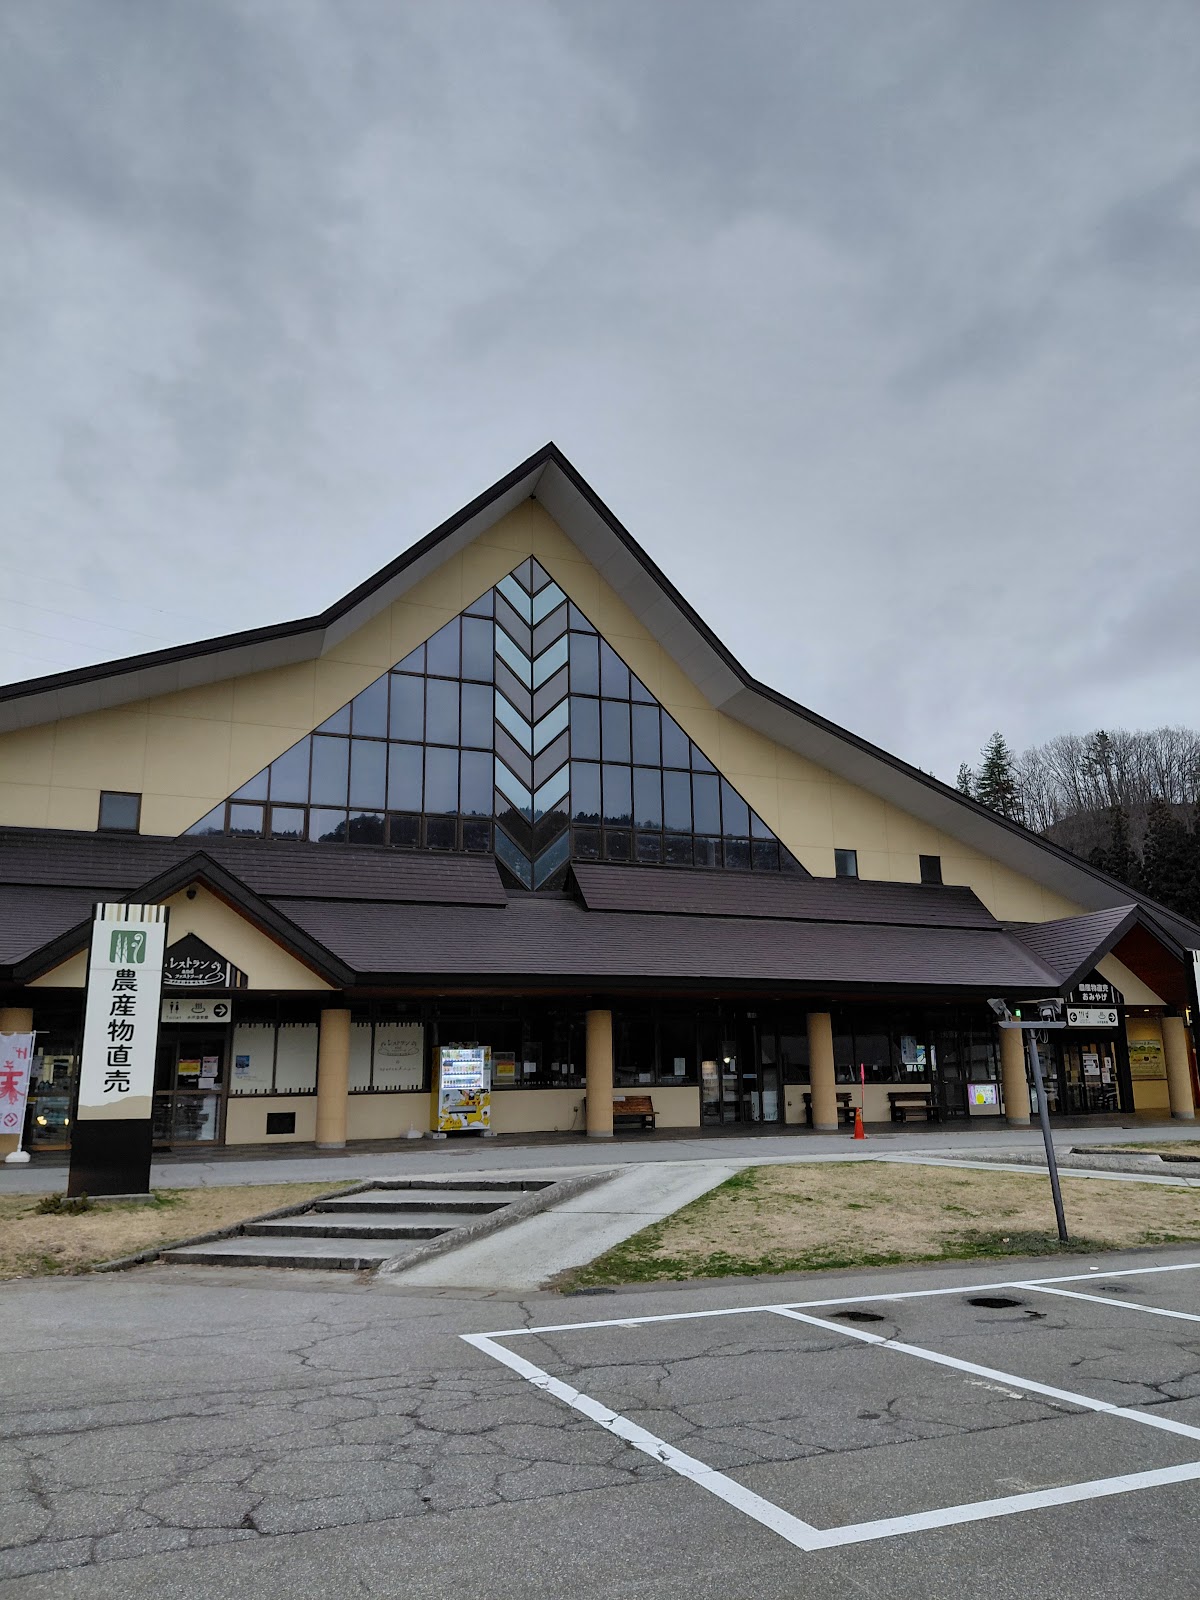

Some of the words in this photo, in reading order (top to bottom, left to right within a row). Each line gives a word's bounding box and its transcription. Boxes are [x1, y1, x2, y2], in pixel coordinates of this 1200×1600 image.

[170, 957, 210, 969] レストラン
[1082, 993, 1107, 1001] おみやげ
[104, 969, 138, 1092] 農産物直売
